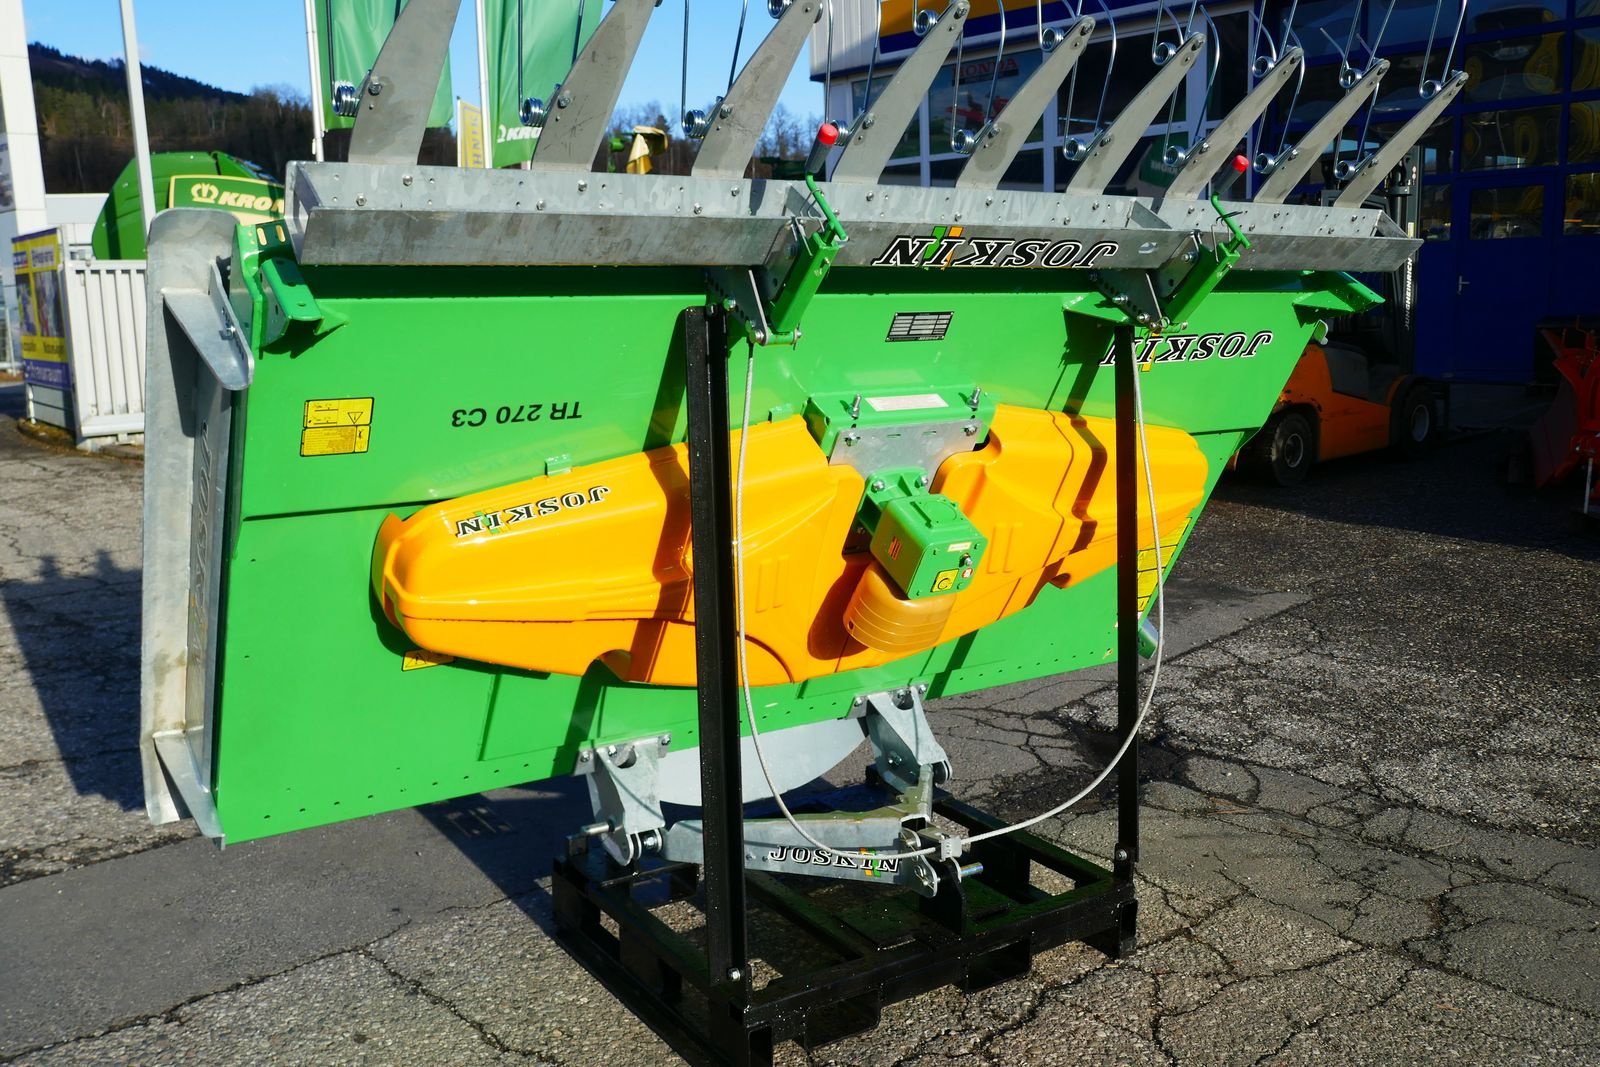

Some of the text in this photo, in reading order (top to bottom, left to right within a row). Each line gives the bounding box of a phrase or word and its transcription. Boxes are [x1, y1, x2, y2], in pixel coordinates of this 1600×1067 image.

[872, 235, 1119, 269] JOSKIN
[451, 401, 583, 427] TR 270 C3
[455, 486, 609, 537] JOSKIN
[768, 845, 901, 872] JOSKIN
